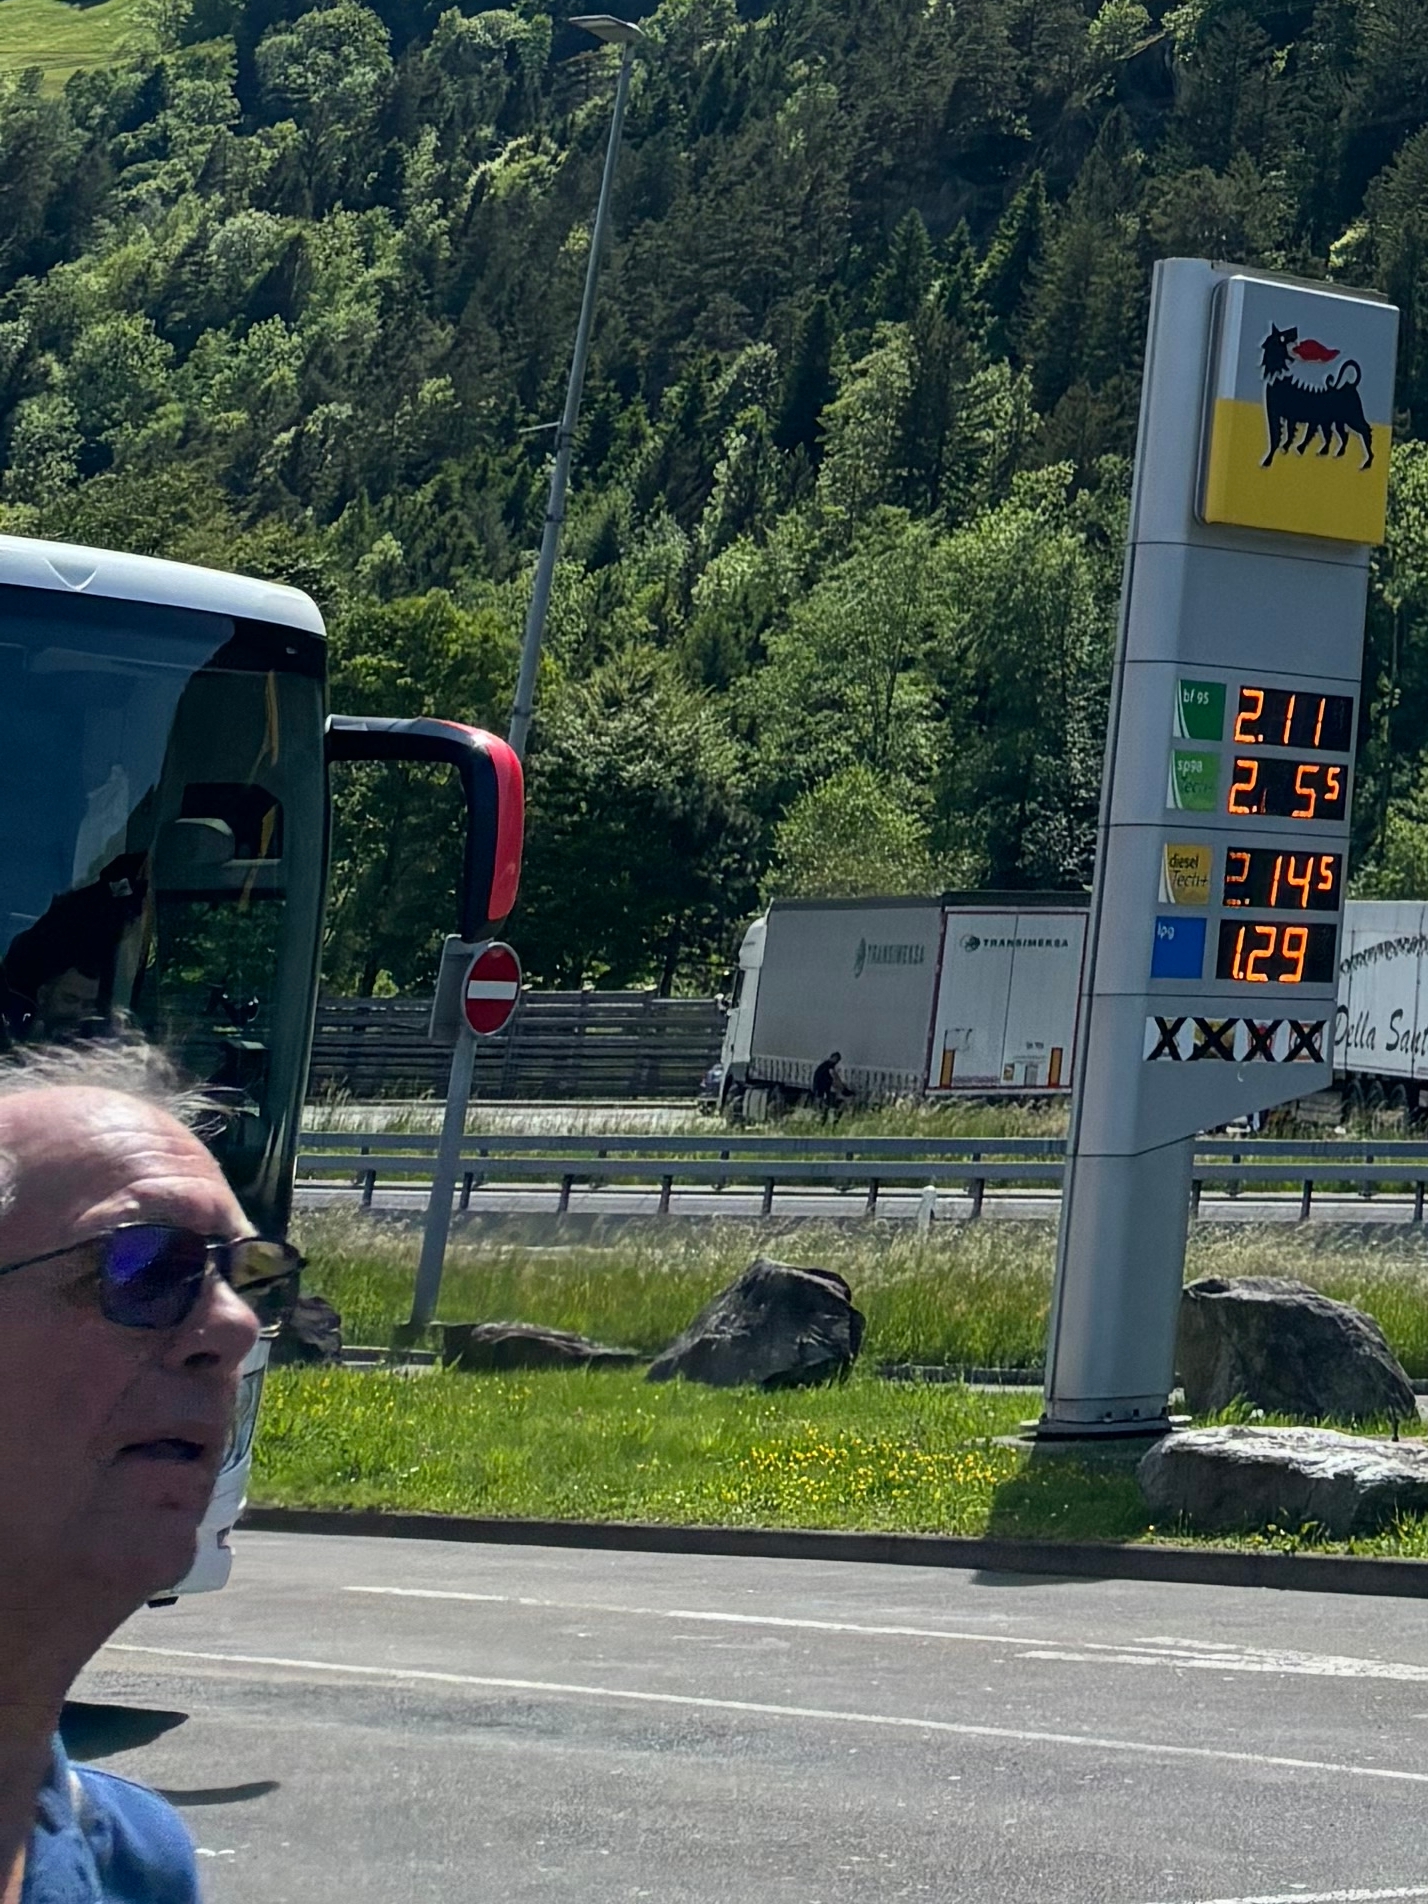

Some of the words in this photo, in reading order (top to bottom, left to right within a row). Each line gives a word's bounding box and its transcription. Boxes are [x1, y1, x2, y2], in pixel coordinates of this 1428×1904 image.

[1197, 691, 1210, 705] 95
[1168, 852, 1199, 870] diesel
[1157, 922, 1175, 940] lpg
[1232, 924, 1309, 983] 1.29
[1334, 1005, 1376, 1051] Della
